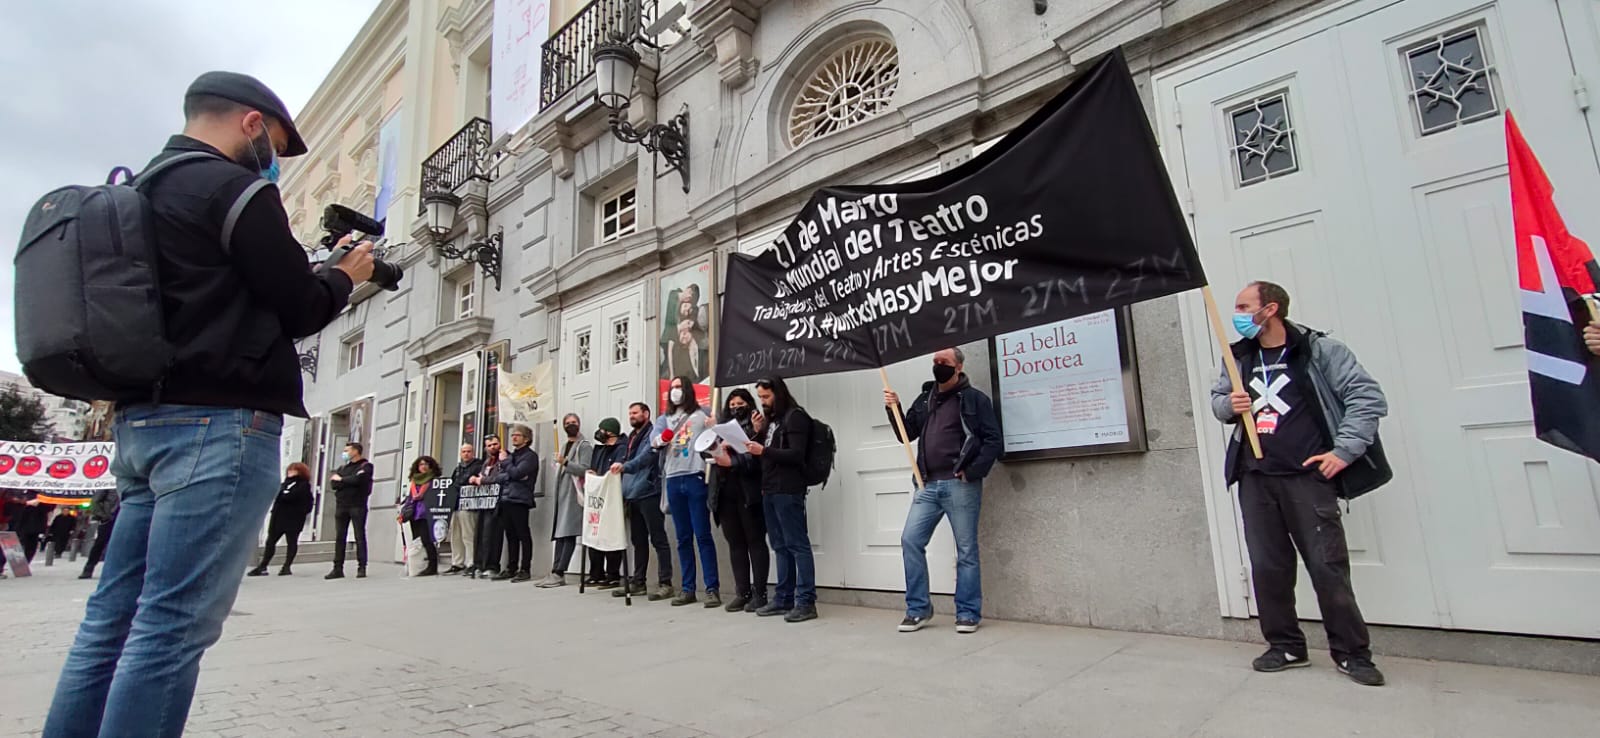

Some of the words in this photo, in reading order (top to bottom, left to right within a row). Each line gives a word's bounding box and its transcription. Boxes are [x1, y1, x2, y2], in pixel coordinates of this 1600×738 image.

[767, 233, 796, 268] 27
[798, 220, 820, 251] de
[817, 193, 898, 235] Marzo
[786, 241, 843, 293] Mundial
[844, 224, 882, 260] del
[888, 195, 988, 242] Teatro
[815, 286, 830, 308] del
[829, 270, 863, 301] Teatro
[863, 268, 871, 289] y
[872, 247, 923, 281] Artes
[930, 214, 1043, 260] Escénicas
[748, 347, 773, 373] 27M
[778, 345, 806, 369] 27M
[872, 317, 912, 354] 27M
[943, 298, 998, 335] 27M
[1021, 275, 1089, 318] 27M
[1103, 247, 1192, 301] 27M
[785, 315, 822, 341] 27M
[1001, 337, 1026, 357] La
[1030, 326, 1078, 352] bella
[1003, 353, 1084, 378] Dorotea
[7, 444, 47, 456] NOS
[52, 443, 113, 456] DEJAN
[432, 478, 453, 489] DEP
